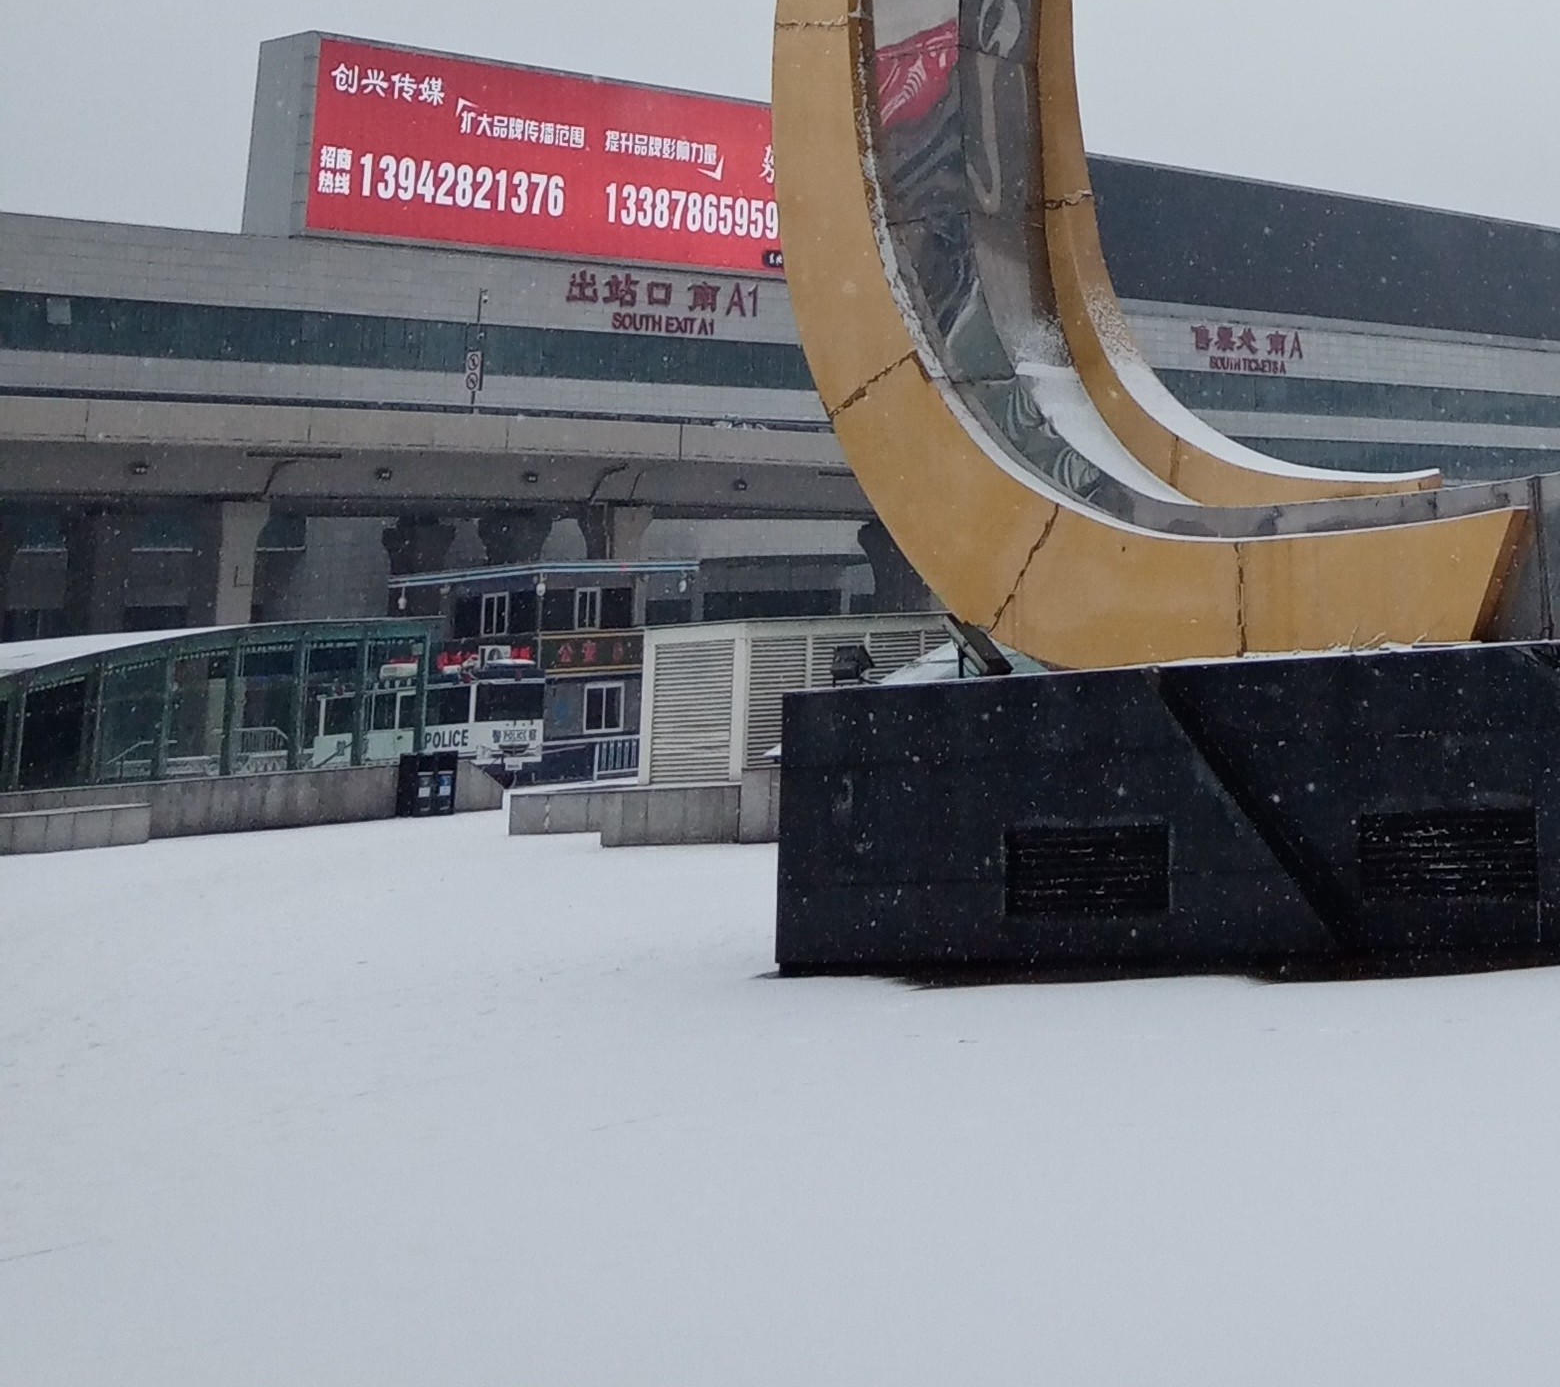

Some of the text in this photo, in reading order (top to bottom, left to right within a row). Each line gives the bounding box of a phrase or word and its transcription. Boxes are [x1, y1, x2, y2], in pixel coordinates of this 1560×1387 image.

[331, 63, 445, 106] 创兴传媒
[460, 111, 585, 149] 扩大品牌传播范围
[320, 145, 352, 171] 招商
[317, 170, 350, 196] 热线
[360, 153, 779, 240] 13942821376 13387865959
[566, 270, 673, 308] 出站口
[612, 311, 715, 336] SOUTH EXIT A1
[424, 729, 469, 749] POLICE
